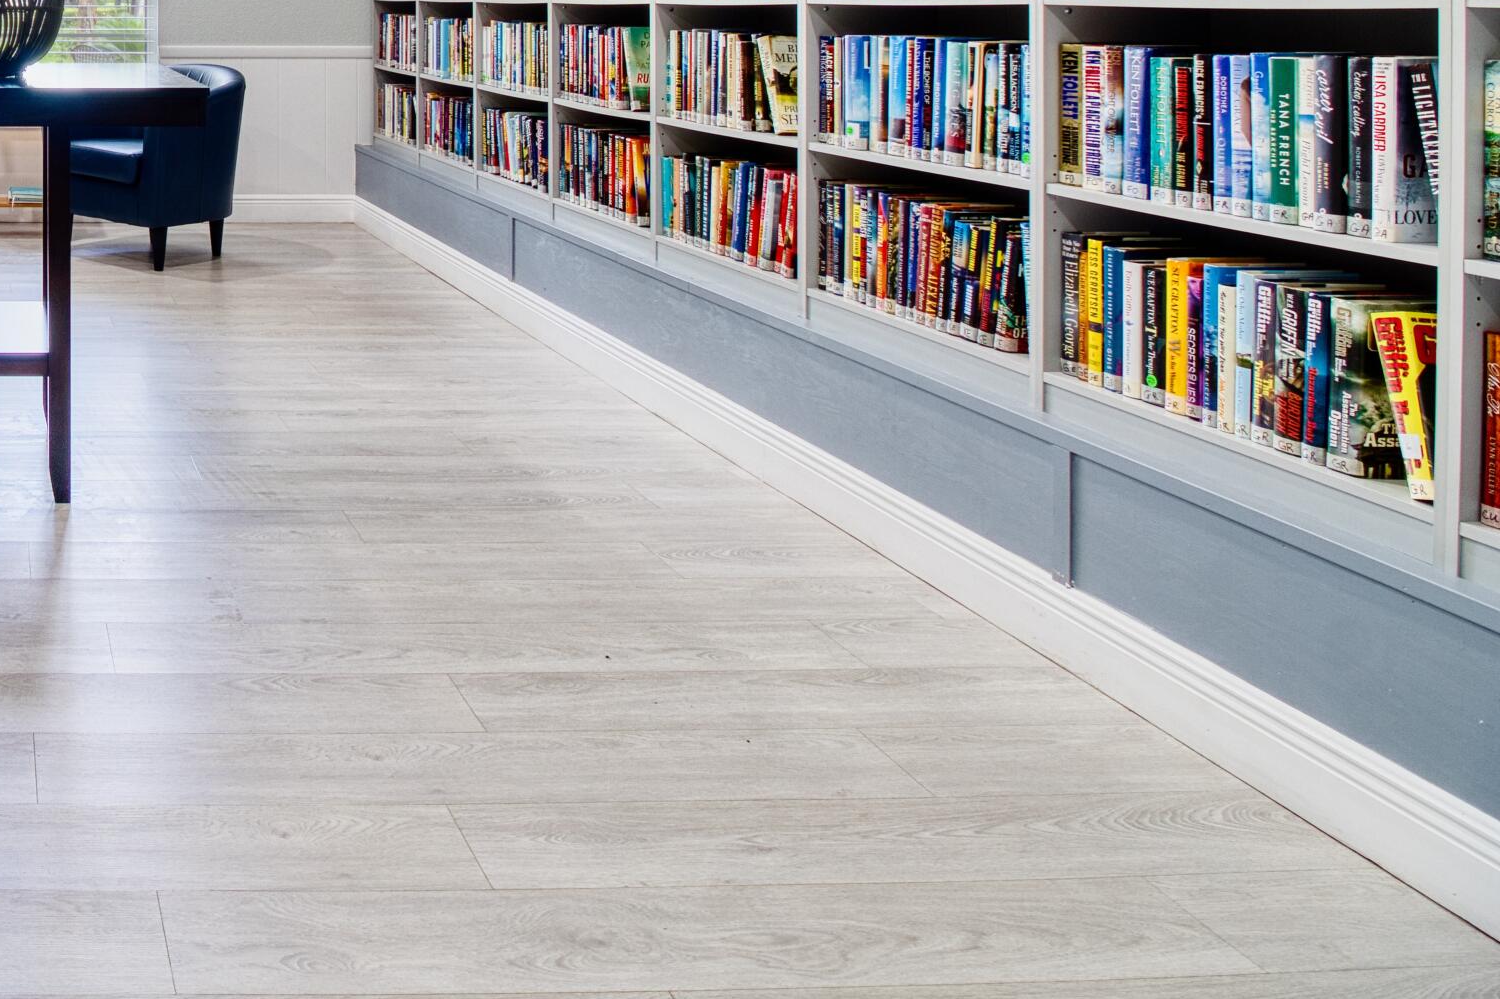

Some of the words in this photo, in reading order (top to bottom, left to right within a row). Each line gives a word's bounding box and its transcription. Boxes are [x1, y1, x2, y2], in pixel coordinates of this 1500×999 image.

[951, 57, 961, 98] GREG
[1062, 51, 1079, 73] KEN
[1131, 56, 1142, 82] KEN
[1410, 73, 1428, 83] THE
[1155, 66, 1167, 93] KEN
[1220, 75, 1229, 115] DOROTHEA
[1314, 69, 1335, 113] career
[1352, 71, 1367, 105] cuckoo's
[1372, 75, 1387, 98] LISA
[1062, 74, 1079, 120] FOLLETT
[1129, 83, 1141, 135] FOLLETT
[1278, 93, 1290, 129] TANA
[1486, 83, 1495, 128] CONROY
[949, 106, 960, 138] ILES
[1155, 95, 1167, 145] FOLLETT
[1313, 112, 1334, 145] evil
[1349, 104, 1366, 138] calling
[1372, 101, 1386, 152] GARDNER
[1300, 140, 1312, 168] Flight
[1411, 85, 1439, 196] LIGHTKEEPERS
[1176, 151, 1186, 167] THE
[1278, 134, 1291, 186] FRENCH
[1176, 167, 1186, 188] AFGHAN
[1301, 170, 1311, 206] Lessons
[1395, 210, 1437, 226] LOVE
[987, 220, 997, 252] JONATHAN
[1003, 239, 1012, 267] JONATHAN
[984, 253, 995, 291] KELLERMAN
[1090, 247, 1099, 268] TESS
[928, 273, 941, 298] ALEX
[1001, 267, 1010, 297] KELLERMAN
[1064, 260, 1079, 315] Elizabeth
[1090, 270, 1100, 319] GERRITSEN
[1257, 286, 1274, 334] Griffin
[1306, 298, 1323, 342] Griffin
[1061, 318, 1078, 359] George
[1281, 308, 1298, 358] GRIFFIN
[1187, 327, 1198, 374] SECRETS
[1187, 381, 1197, 404] LIES
[1253, 360, 1264, 416] Traffickers
[1263, 378, 1274, 396] The
[1305, 367, 1318, 420] Hazardous
[1486, 361, 1500, 392] Mrs.
[1340, 391, 1352, 454] Assassination
[1349, 403, 1358, 418] The
[1486, 394, 1499, 418] Poe
[1304, 421, 1314, 442] Duty
[1328, 410, 1342, 448] Option
[1488, 437, 1496, 459] LYNN
[1488, 461, 1496, 495] CULLEN
